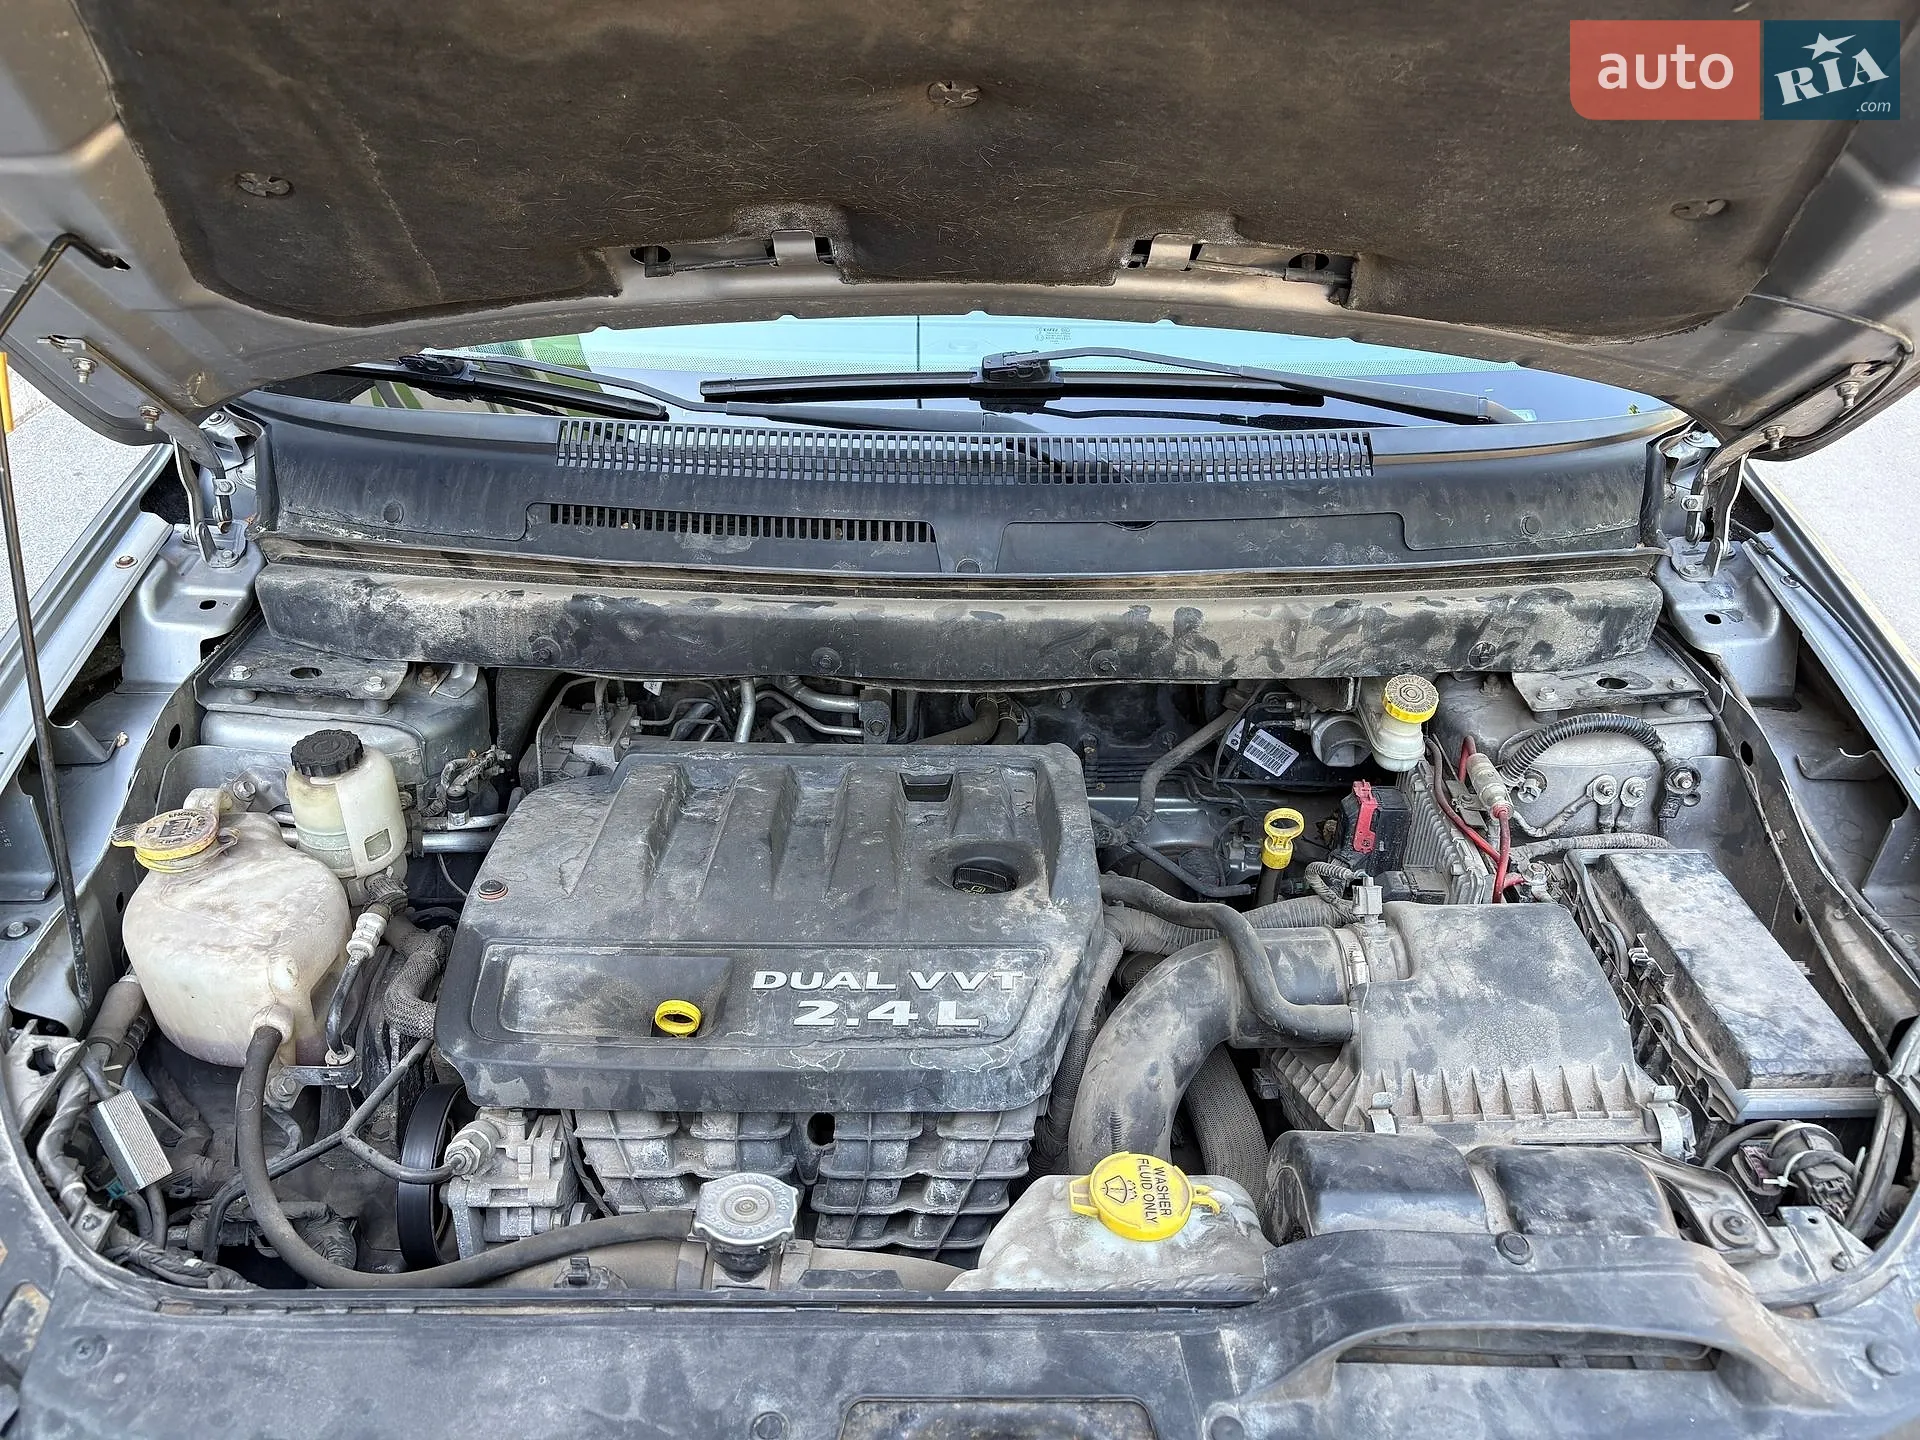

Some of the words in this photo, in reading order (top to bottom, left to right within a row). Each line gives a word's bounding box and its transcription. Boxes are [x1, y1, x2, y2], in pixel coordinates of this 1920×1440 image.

[751, 970, 898, 991] DUAL
[908, 971, 1024, 992] VVT
[1137, 1158, 1153, 1191] FLUID
[1153, 1166, 1172, 1217] WASHER
[1142, 1193, 1159, 1224] ONLY
